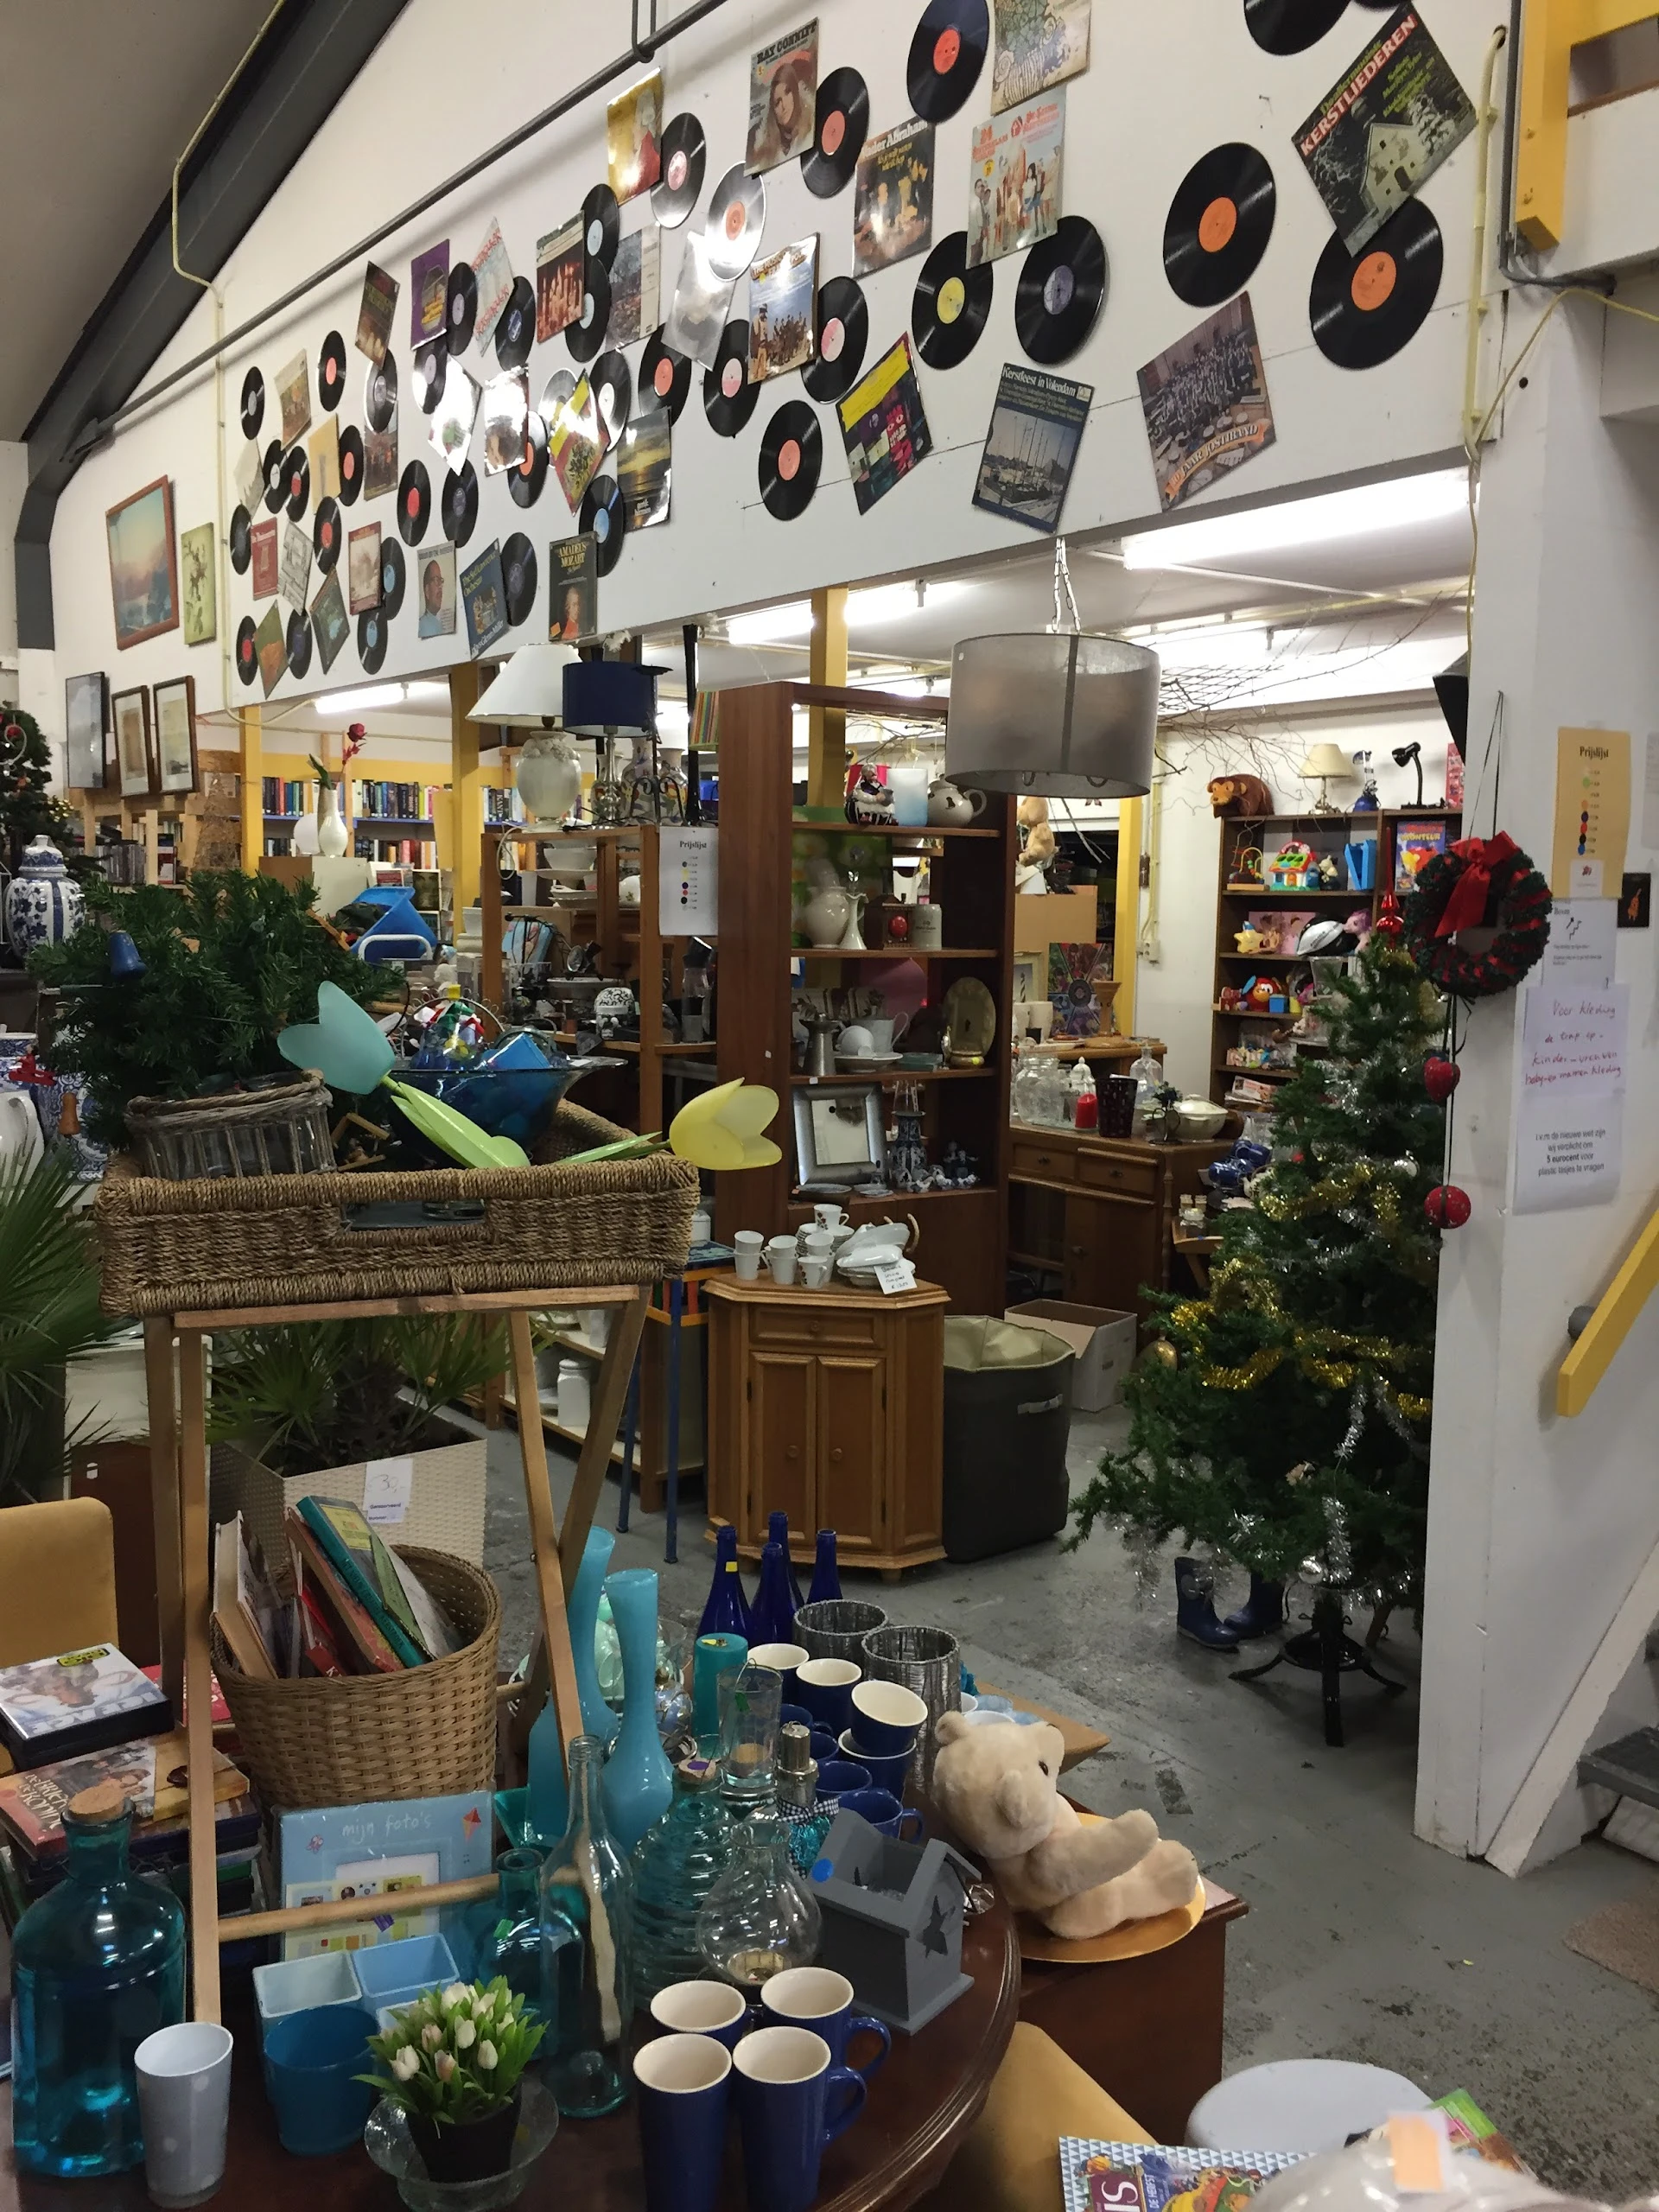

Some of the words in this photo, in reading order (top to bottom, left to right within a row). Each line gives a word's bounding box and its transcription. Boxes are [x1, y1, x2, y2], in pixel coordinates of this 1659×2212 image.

[757, 44, 776, 64] RAY
[776, 21, 817, 53] CONNIFF
[1300, 14, 1418, 156] KERSTLIEDEREN
[886, 119, 928, 148] Abraham
[1002, 366, 1037, 386] Kerstfeest
[1037, 375, 1046, 389] in
[1046, 378, 1076, 397] Volendam
[558, 542, 587, 558] AMADEUS
[561, 553, 586, 568] MOZART
[1580, 746, 1609, 760] Prijslijst
[679, 841, 707, 849] Prijslijst
[1553, 1000, 1572, 1016] Voor
[1560, 1032, 1580, 1042] trap
[1595, 1128, 1606, 1138] zijn
[1557, 1142, 1582, 1151] verplicht
[1547, 1154, 1551, 1163] 5
[1552, 1154, 1580, 1162] eurocent
[1538, 1167, 1557, 1177] plastic
[1558, 1166, 1575, 1175] tasjes
[1583, 1163, 1605, 1173] vragen
[101, 1692, 157, 1716] ICE
[32, 1707, 97, 1734] AGE
[341, 1818, 374, 1845] mijn
[385, 1811, 431, 1837] foto's
[1143, 2173, 1159, 2198] HERFST
[1147, 2198, 1160, 2209] DE
